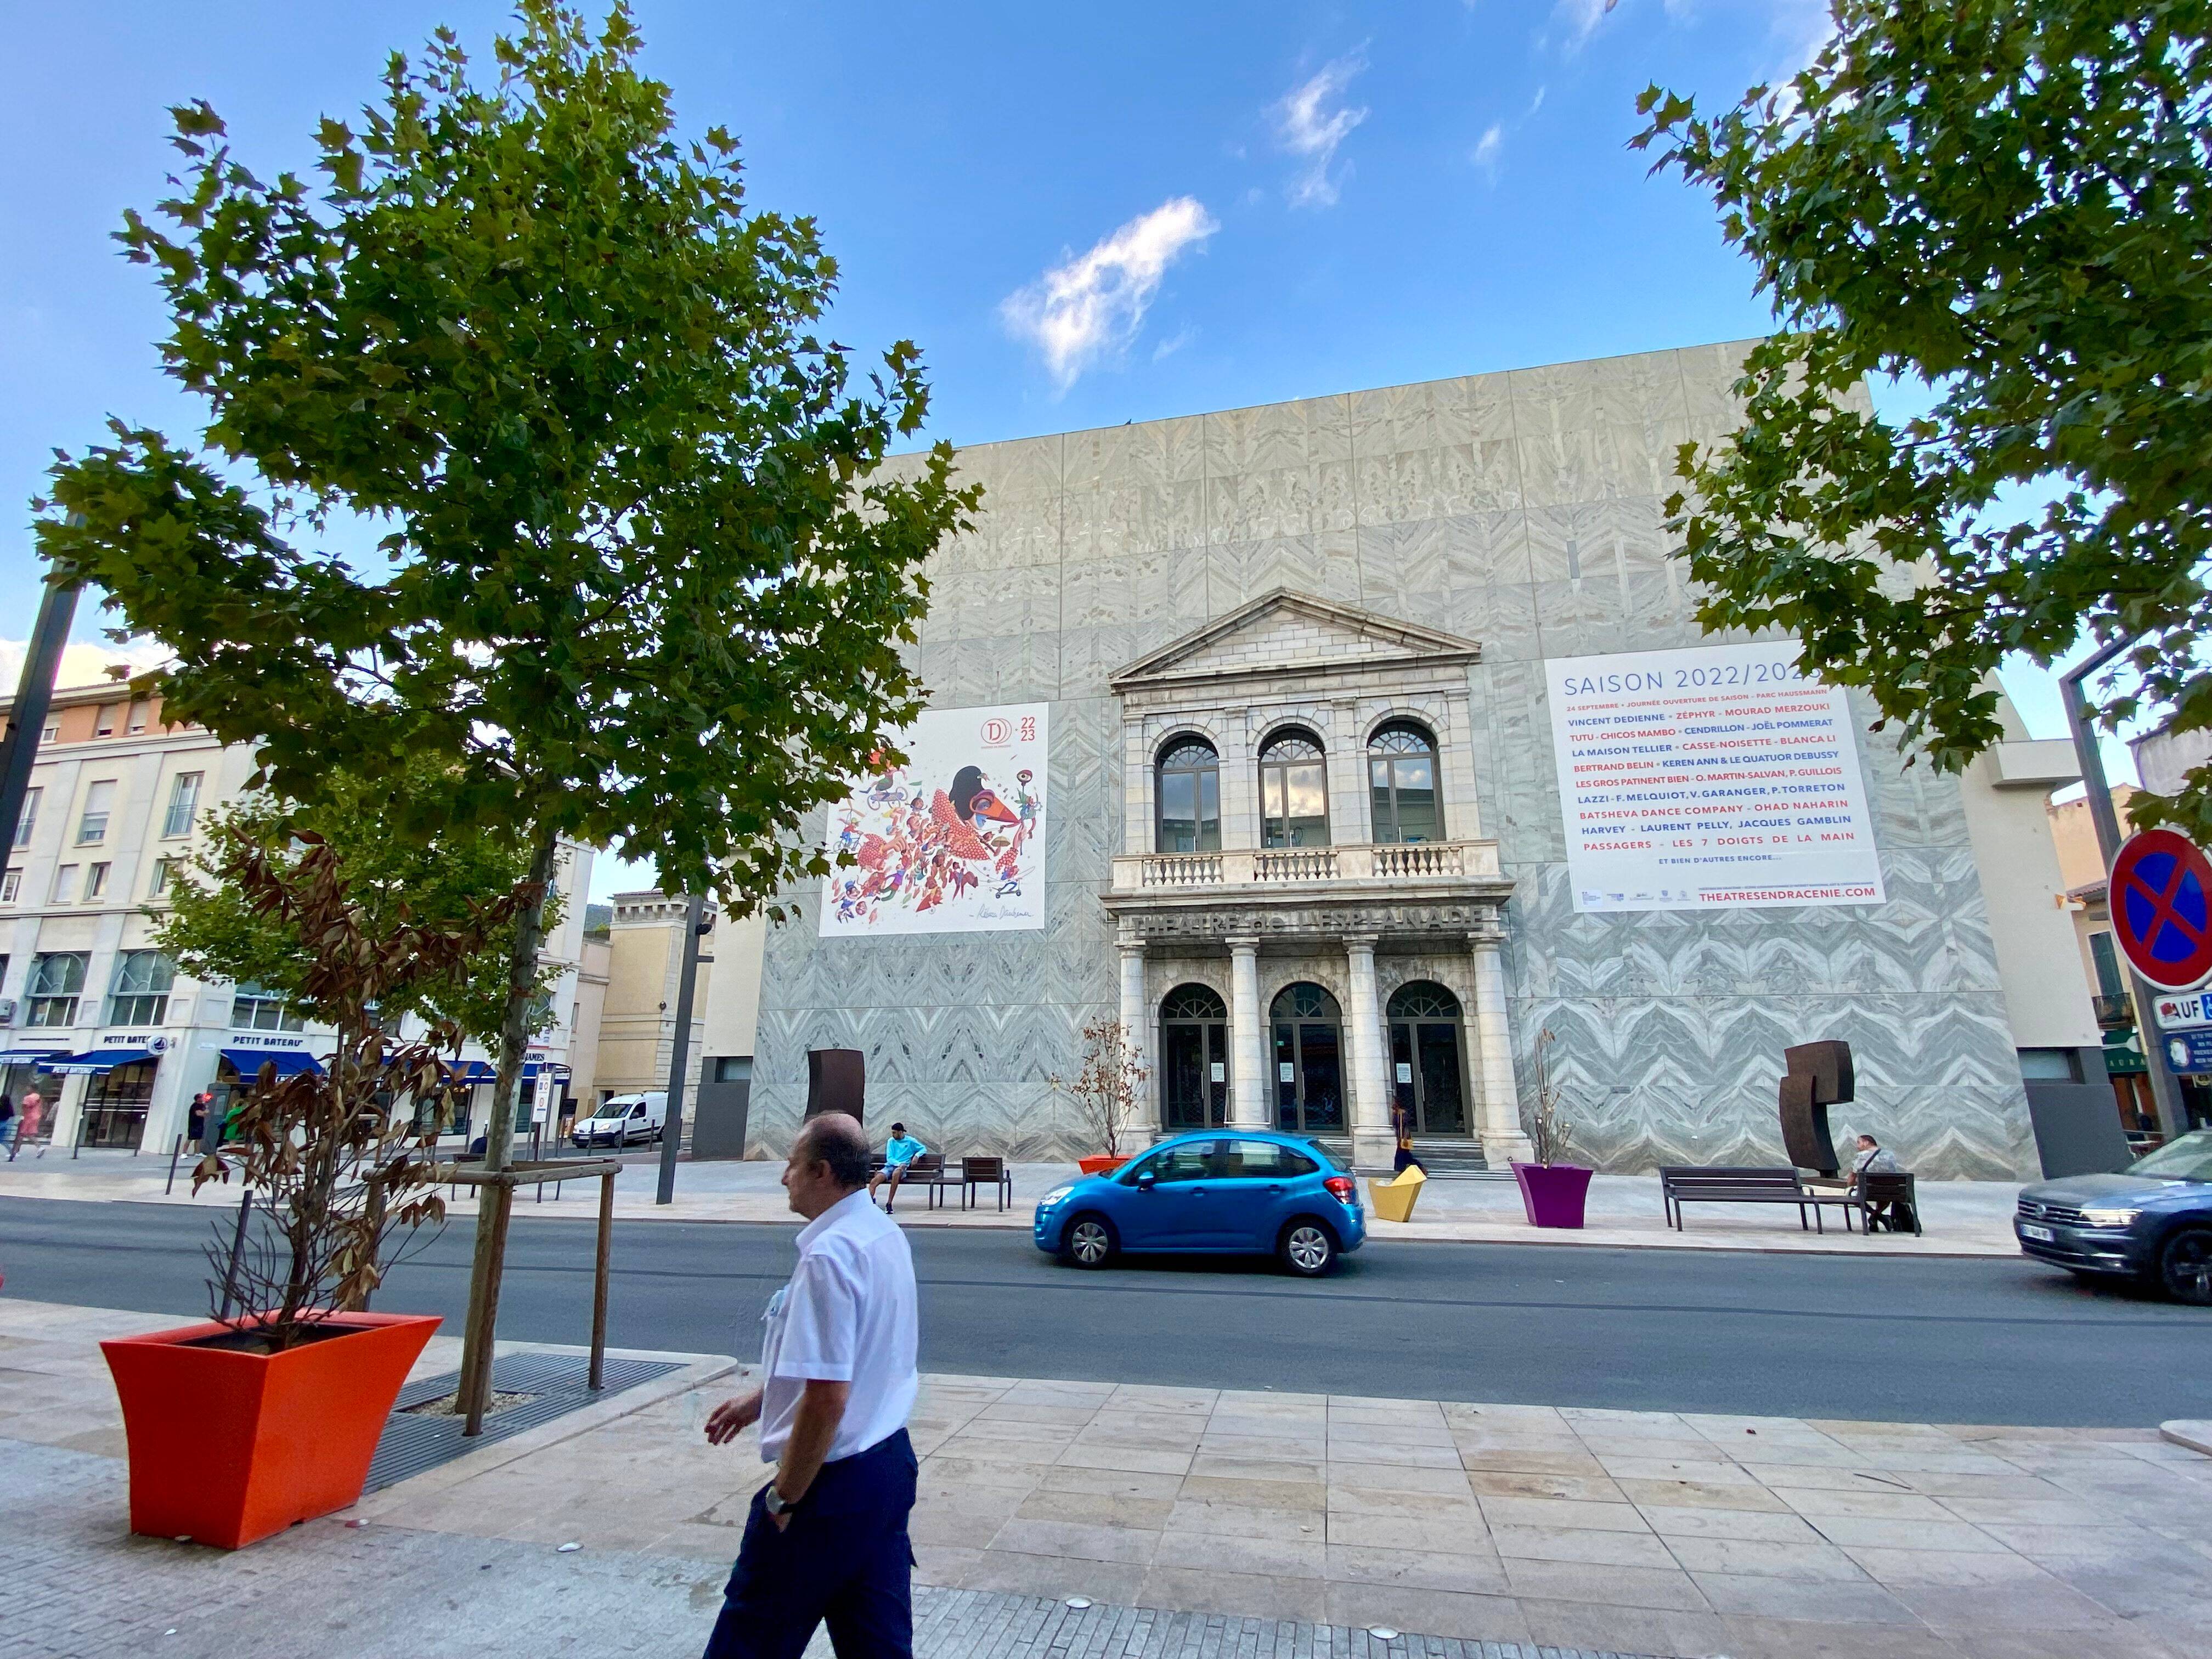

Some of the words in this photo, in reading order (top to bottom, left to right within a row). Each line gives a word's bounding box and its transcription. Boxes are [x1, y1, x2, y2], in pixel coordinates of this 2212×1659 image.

[1565, 671, 1662, 696] SAISON
[1577, 703, 1619, 711] SEPTEMBRE
[1627, 699, 1661, 708] JOURNÉE
[1662, 697, 1707, 705] OUVERTURE
[1778, 689, 1827, 697] HAUSSMANN
[1020, 716, 1035, 729] 22
[1568, 717, 1611, 726] VINCENT
[1613, 713, 1666, 724] DEDIENNE
[1675, 710, 1716, 720] ZÉPHYR
[1725, 707, 1771, 716] MOURAD
[1774, 703, 1830, 713] MERZOUKI
[1020, 729, 1035, 741] 23
[1569, 733, 1594, 742] TUTU
[1600, 731, 1636, 740] CHICOS
[1637, 729, 1676, 738] MAMBO
[1684, 724, 1745, 735] CENDRILLON
[1751, 720, 1776, 731] JOËL
[1776, 719, 1833, 729] POMMERAT
[1587, 747, 1630, 757] MAISON
[1632, 744, 1673, 753] TELLIER
[1682, 738, 1772, 751] CASSE-NOISETTE
[1780, 736, 1825, 745] BLANCA
[1573, 763, 1625, 773] BERTRAND
[1626, 761, 1654, 770] BELIN
[1662, 759, 1695, 768] KEREN
[1696, 758, 1719, 766] ANN
[1742, 753, 1792, 763] QUATUOR
[1793, 751, 1839, 760] DEBUSSY
[1576, 780, 1592, 788] LES
[1593, 778, 1620, 787] GROS
[1621, 776, 1666, 786] PATINENT
[1667, 775, 1689, 783] BIEN
[1798, 767, 1842, 776] GUILLOIS
[1578, 795, 1609, 804] LAZZI
[1781, 783, 1845, 793] TORRETON
[1579, 810, 1638, 820] BATSHEVA
[1641, 808, 1681, 817] DANCE
[1684, 805, 1743, 815] COMPANY
[1754, 803, 1789, 811] OHAD
[1793, 800, 1848, 810] NAHARIN
[1582, 826, 1626, 835] HARVEY
[1640, 822, 1691, 832] LAURENT
[1738, 818, 1791, 828] JACQUES
[1797, 816, 1851, 826] GAMBLIN
[1584, 841, 1651, 851] PASSAGERS
[1701, 838, 1708, 847] 7
[1717, 836, 1763, 845] DOIGTS
[1772, 835, 1788, 843] DE
[1821, 832, 1854, 841] MAIN
[1699, 888, 1875, 902] THEATRESENDRACENIE.COM
[1250, 912, 1285, 933] de
[2171, 1000, 2199, 1019] AUF
[233, 1036, 261, 1044] PETIT
[263, 1037, 301, 1047] BATEAU
